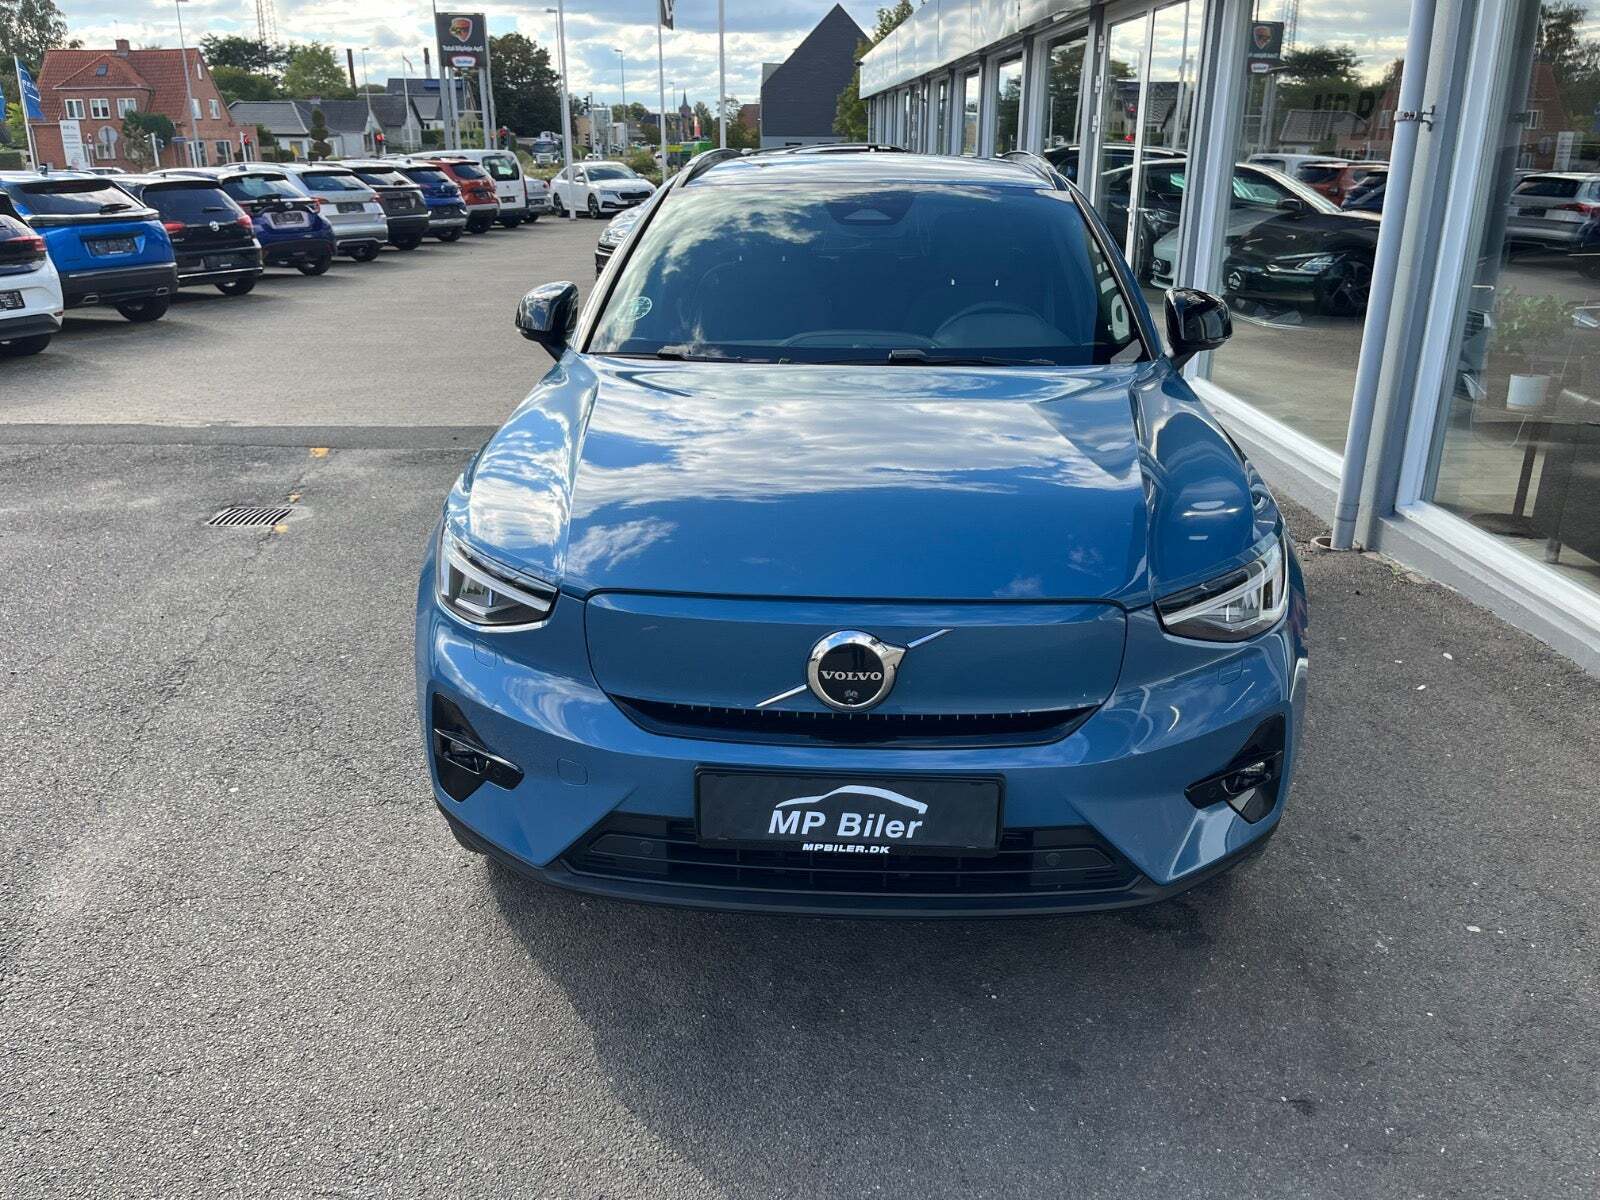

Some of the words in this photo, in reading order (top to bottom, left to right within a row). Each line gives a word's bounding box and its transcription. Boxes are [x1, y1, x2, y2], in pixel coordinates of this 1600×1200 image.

[820, 670, 882, 681] VOLVO
[768, 810, 826, 835] MP
[837, 812, 923, 839] Biler
[802, 843, 890, 854] MPBILER.DK
